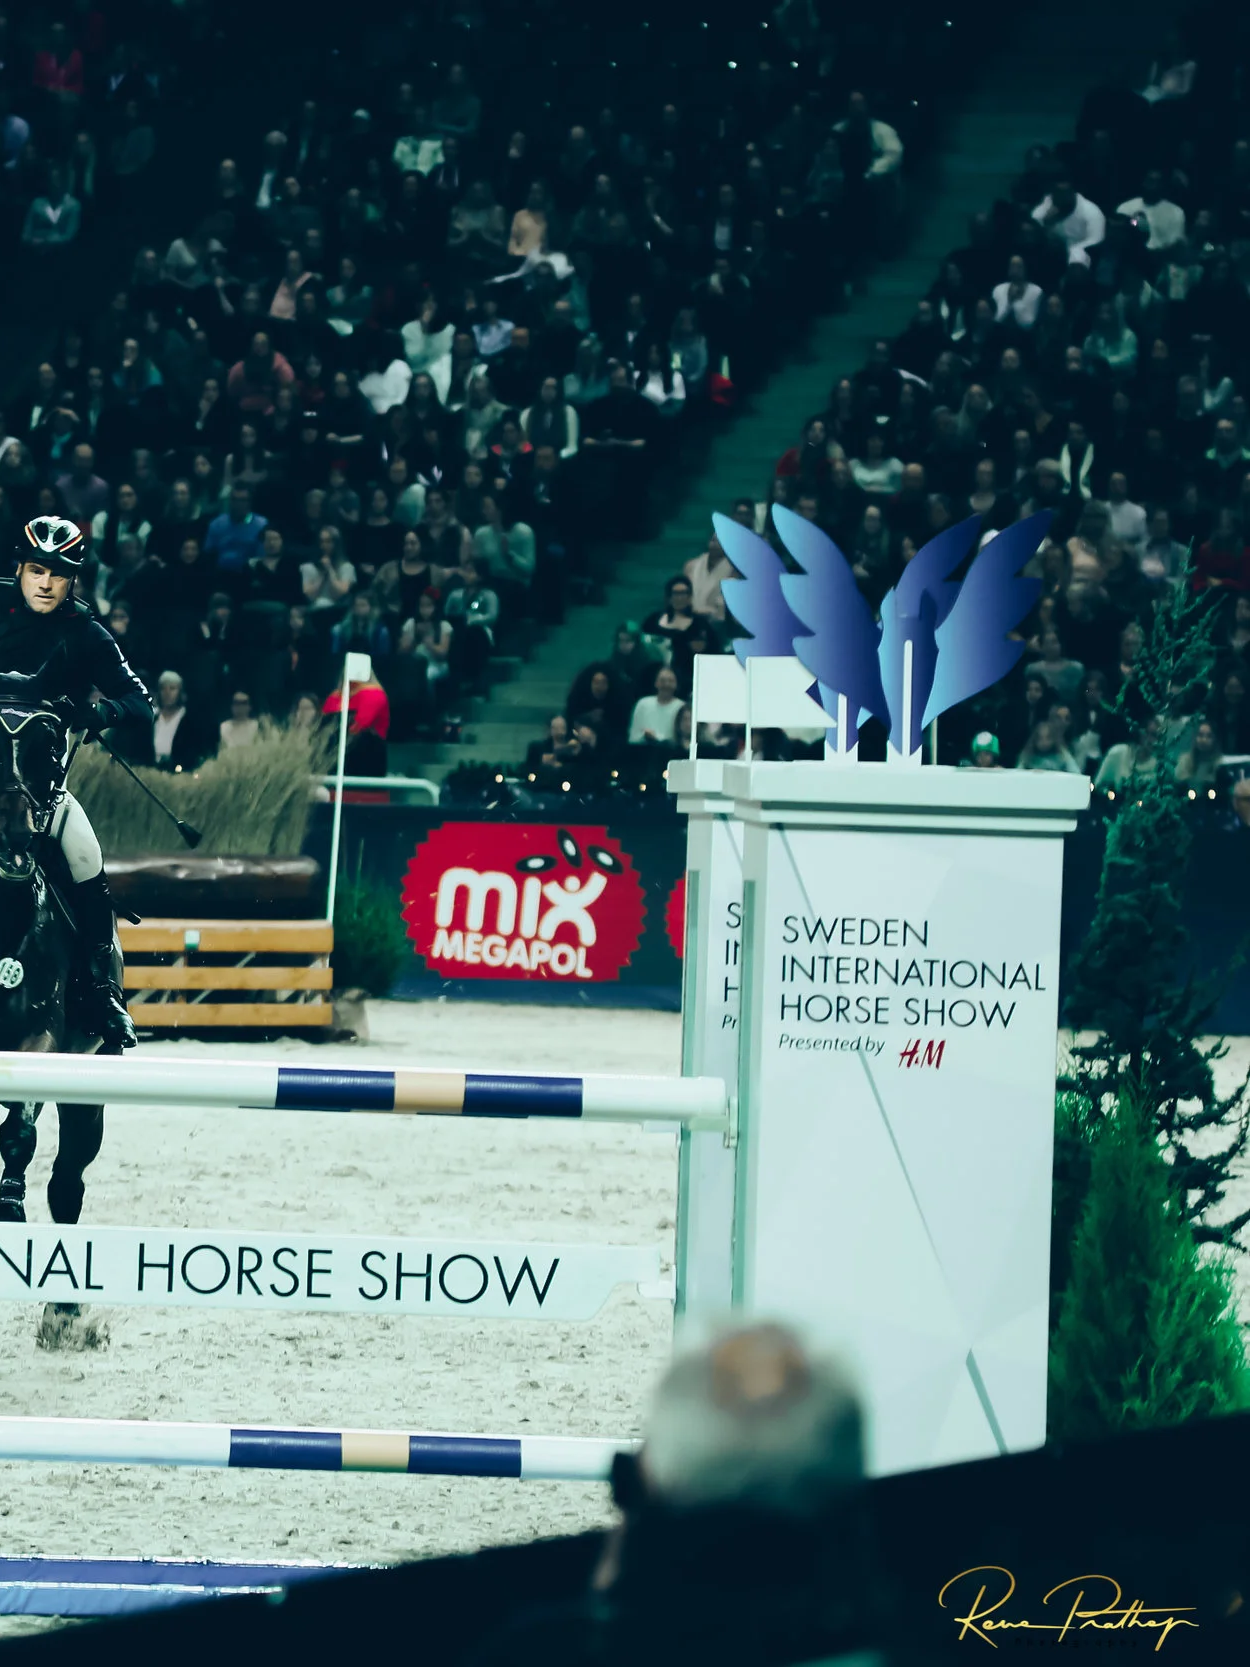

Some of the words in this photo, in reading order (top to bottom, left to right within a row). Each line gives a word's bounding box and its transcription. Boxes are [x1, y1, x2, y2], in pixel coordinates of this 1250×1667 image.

[782, 915, 929, 948] SWEDEN
[431, 928, 593, 979] MEGAPOL
[781, 955, 1046, 992] INTERNATIONAL
[780, 993, 890, 1025] HORSE
[903, 997, 1017, 1029] SHOW
[778, 1032, 861, 1052] Presented
[864, 1036, 886, 1057] by
[136, 1242, 333, 1299] HORSE
[357, 1250, 561, 1308] SHOW
